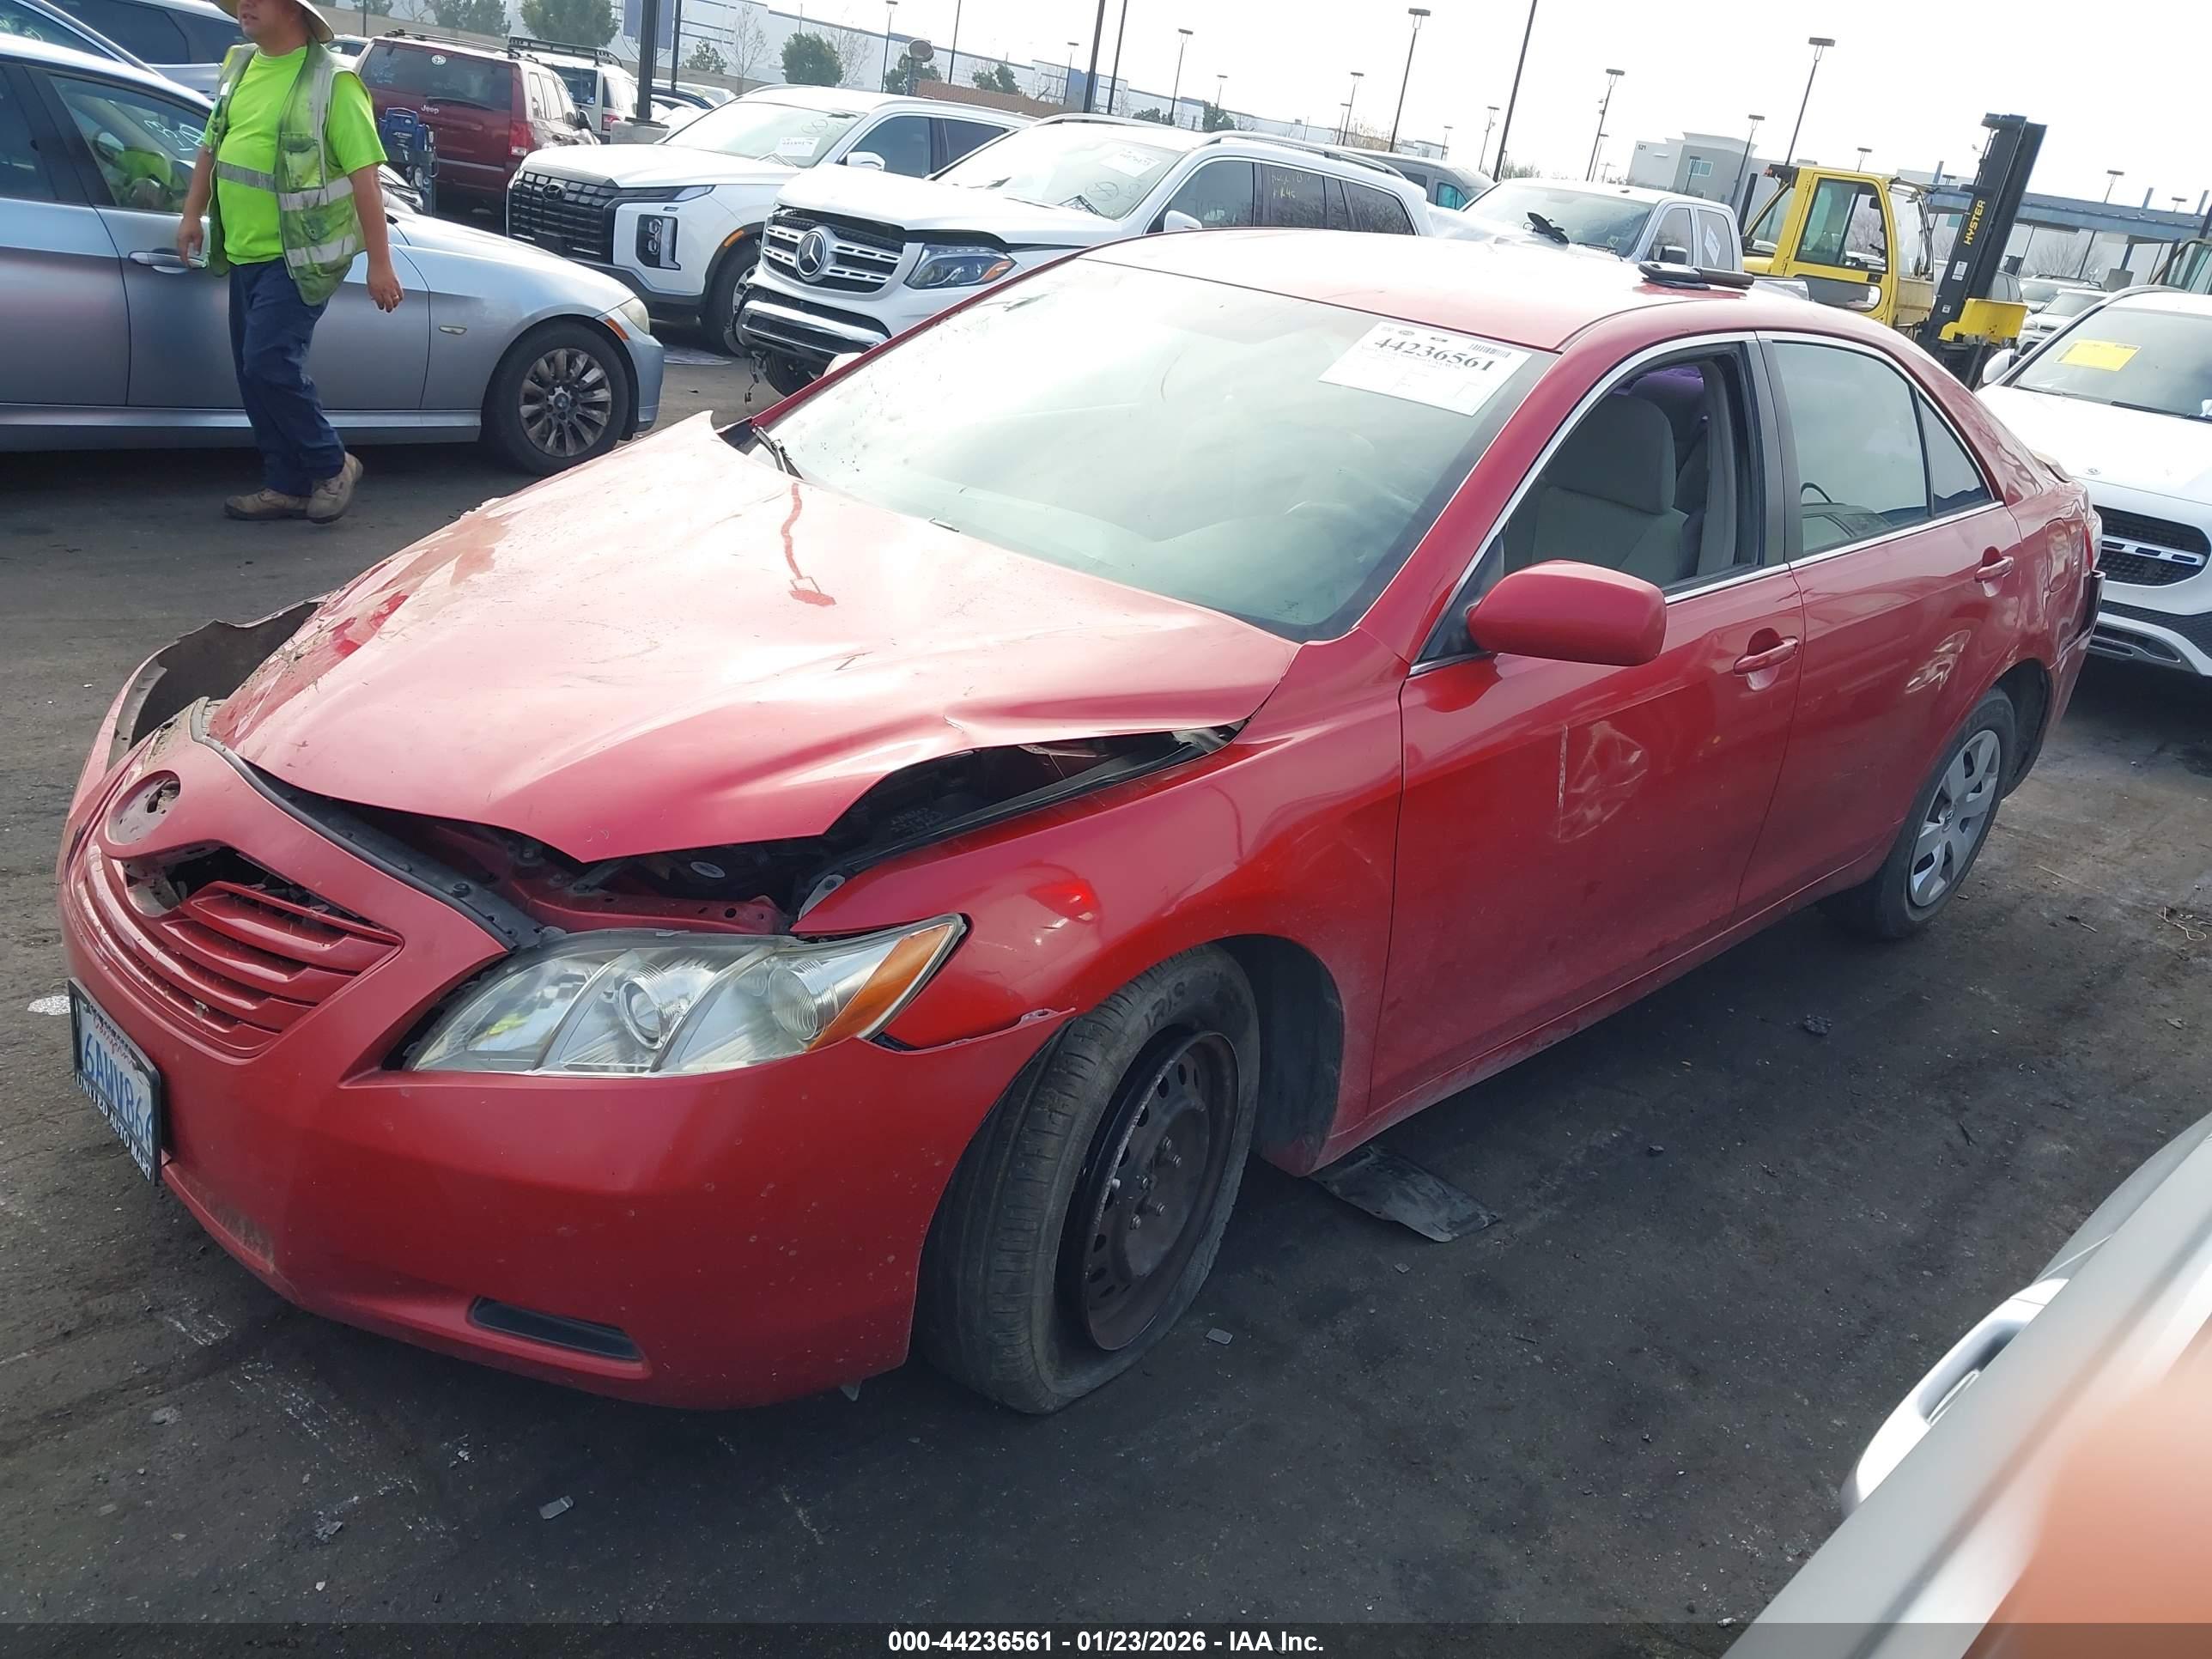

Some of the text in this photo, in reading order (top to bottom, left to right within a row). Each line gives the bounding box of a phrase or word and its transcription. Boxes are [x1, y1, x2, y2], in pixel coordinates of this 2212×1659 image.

[421, 104, 440, 115] Jeep
[1964, 199, 1986, 246] HYSTER
[1375, 337, 1495, 372] 44236561
[76, 1073, 152, 1182] UNITED AUTO MART
